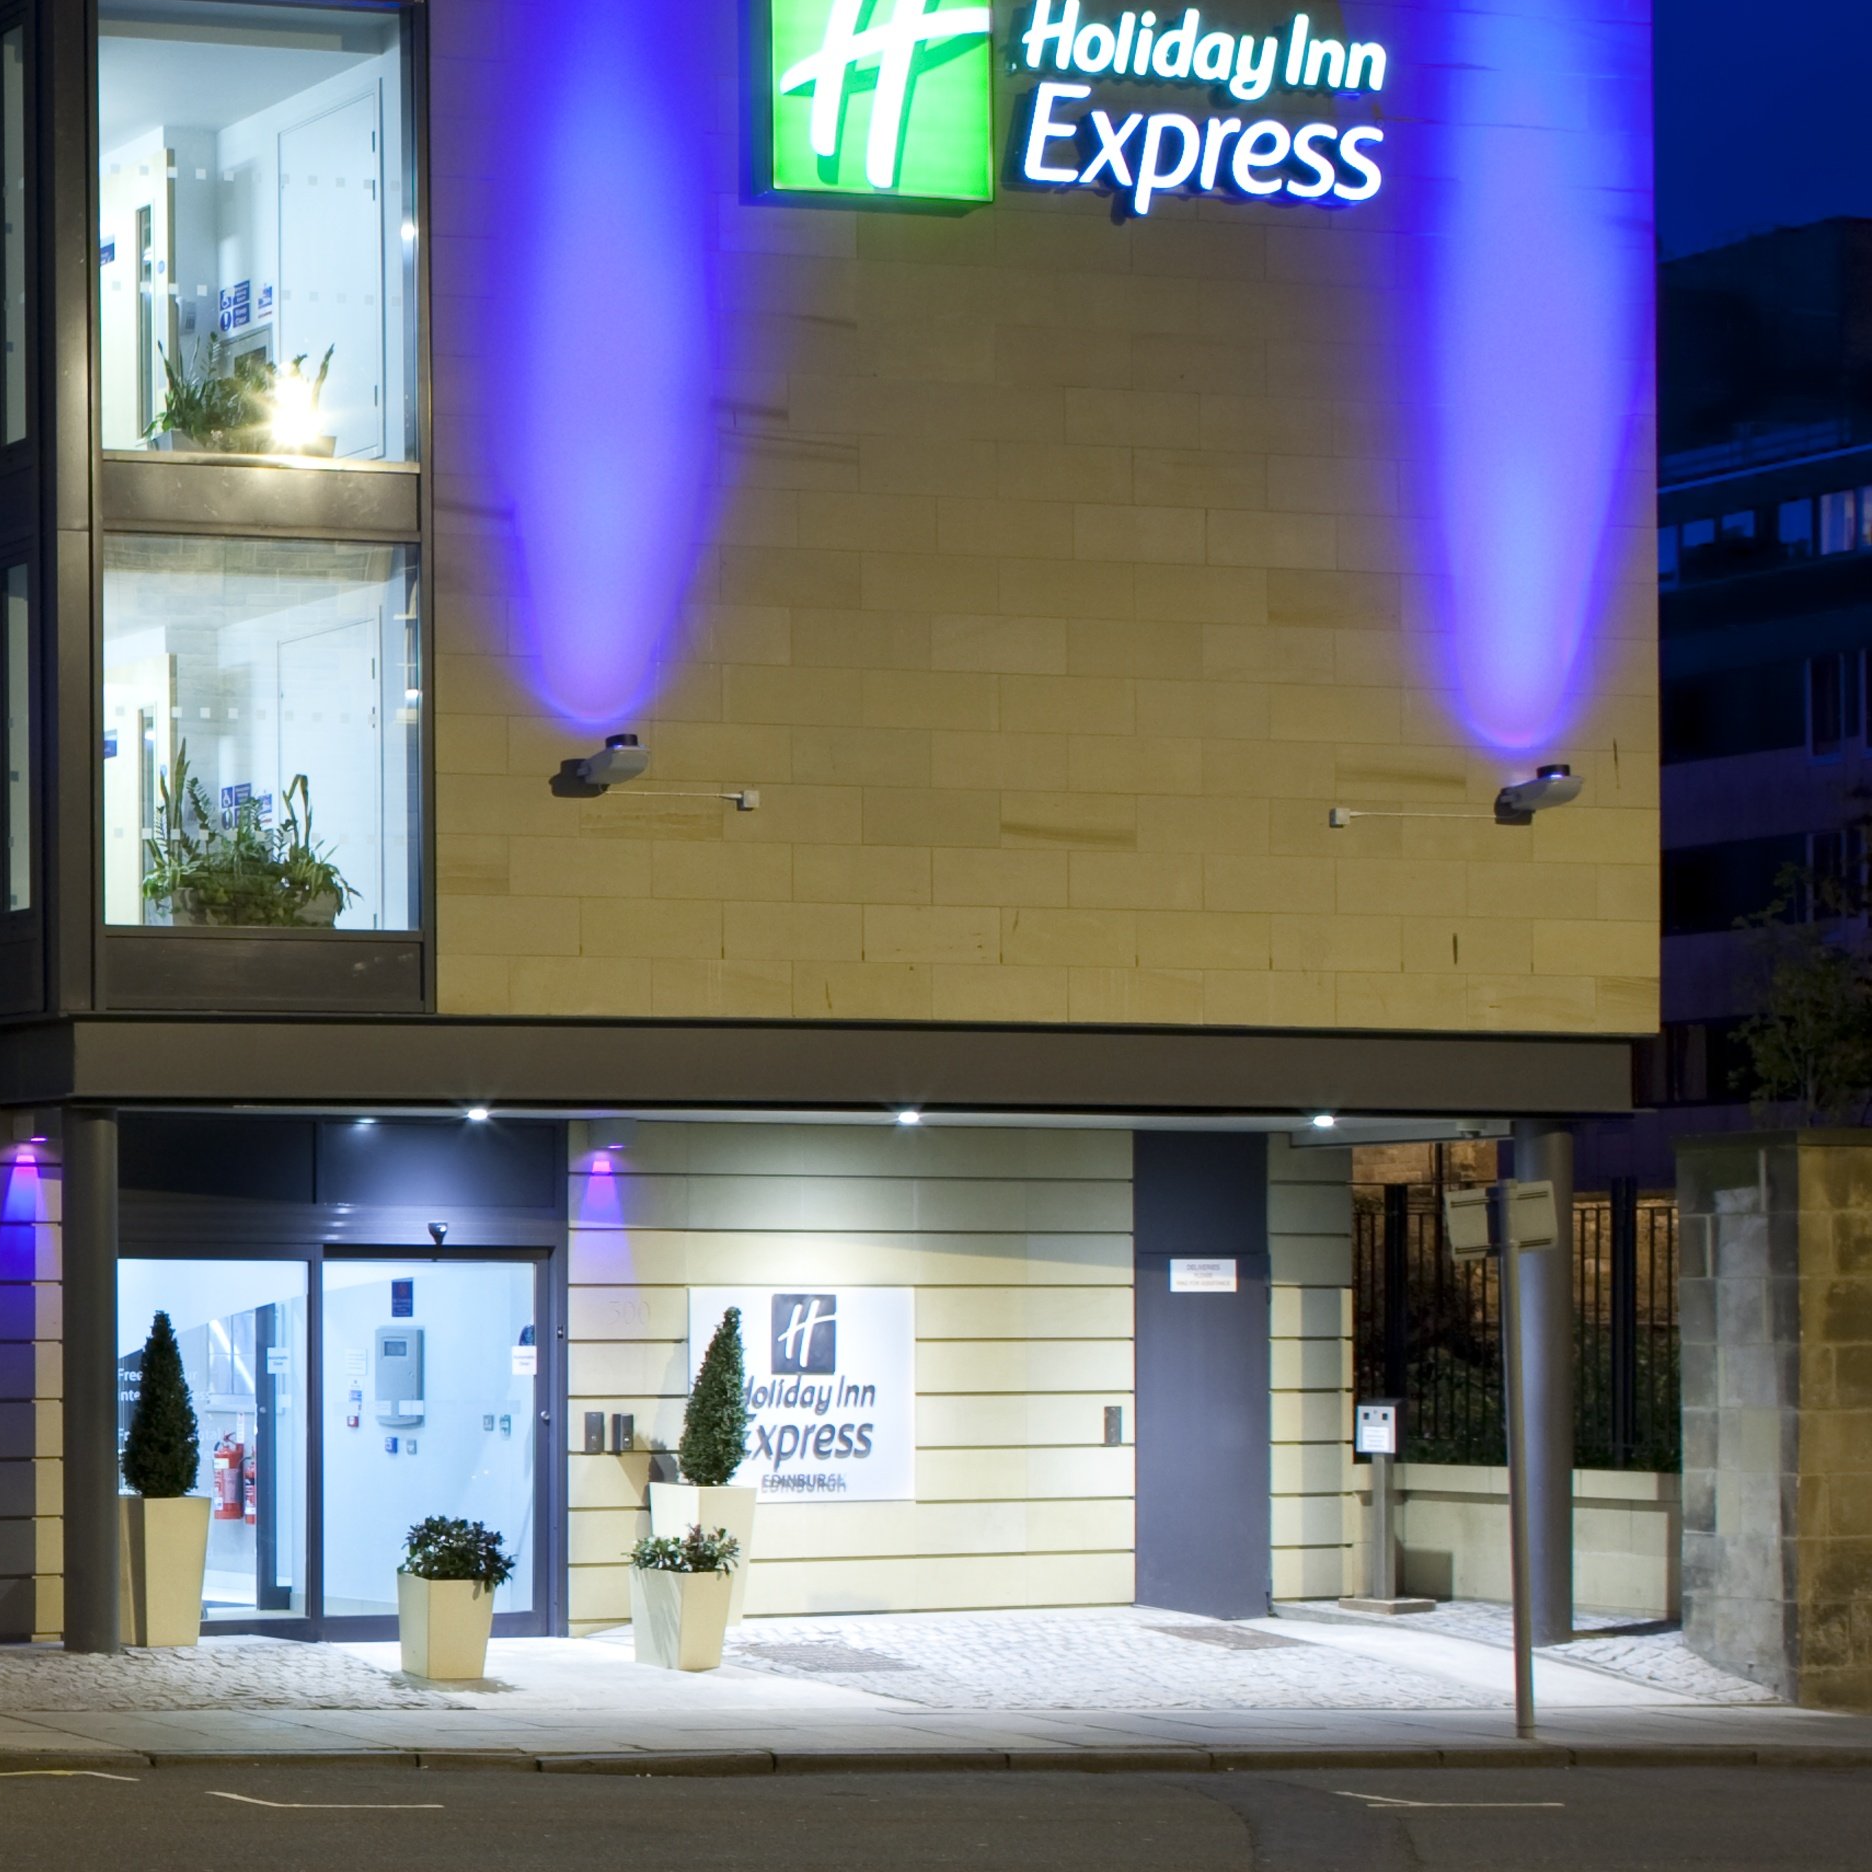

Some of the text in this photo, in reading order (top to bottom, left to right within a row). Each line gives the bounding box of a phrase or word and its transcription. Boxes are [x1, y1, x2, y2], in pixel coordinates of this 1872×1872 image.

[1284, 12, 1387, 92] Inn
[1022, 81, 1384, 215] Express
[836, 1375, 876, 1408] Inn
[761, 1473, 847, 1493] EDINBURGH
